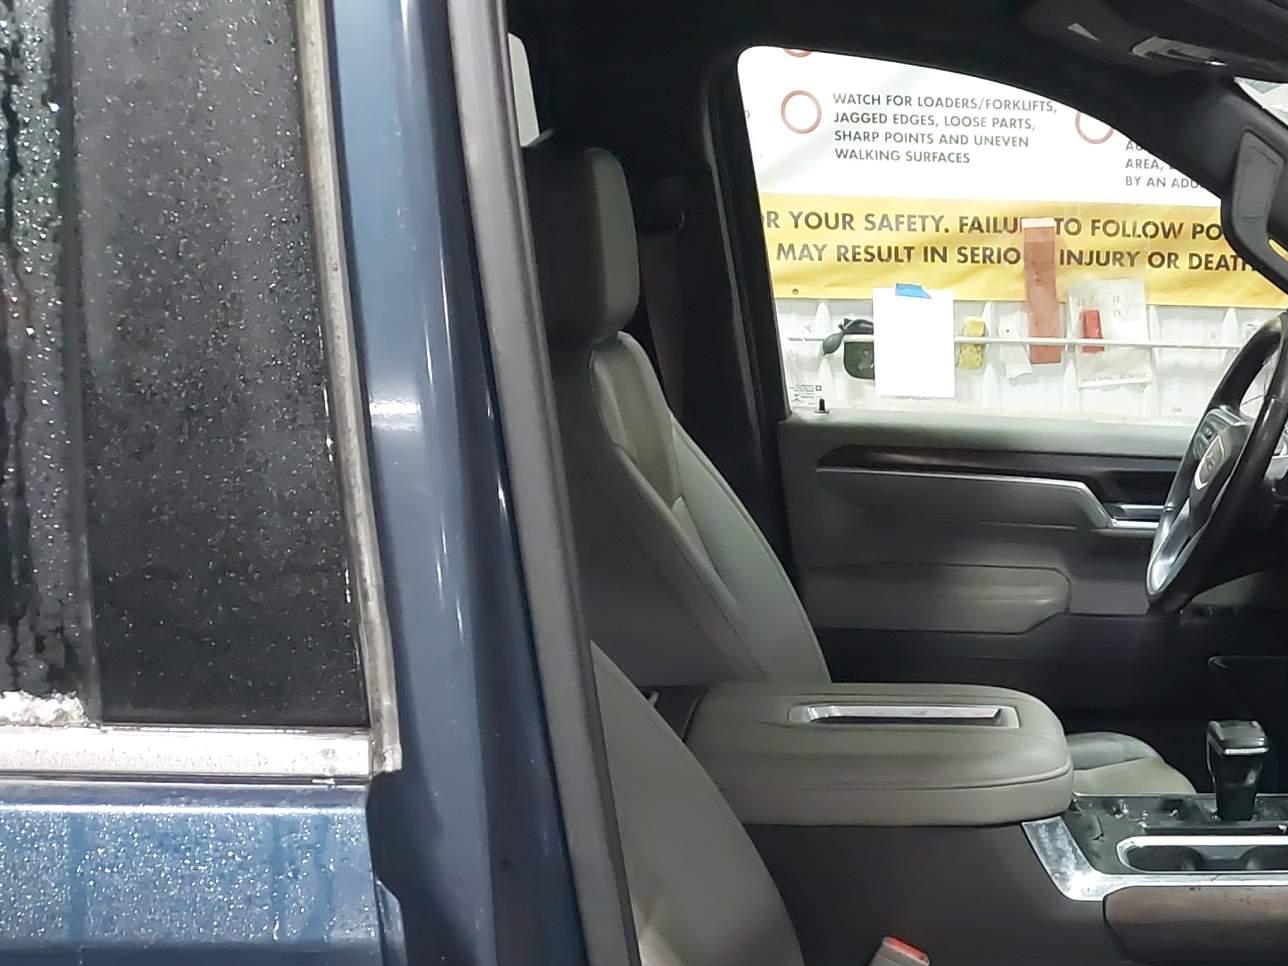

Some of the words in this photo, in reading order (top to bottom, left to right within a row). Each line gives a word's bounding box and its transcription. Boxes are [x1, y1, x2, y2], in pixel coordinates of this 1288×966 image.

[833, 92, 881, 106] WATCH
[886, 94, 912, 107] FOR
[917, 96, 1057, 114] LOADERS/FORKLIFTS,
[833, 112, 887, 126] JAGGED
[893, 114, 939, 128] EDGES,
[944, 116, 987, 128] LOOSE
[991, 117, 1036, 131] PARTS,
[834, 130, 879, 142] SHARP
[884, 133, 934, 145] POINTS
[939, 134, 969, 146] AND
[973, 135, 1029, 148] UNEVEN
[835, 148, 900, 162] WALKING
[905, 151, 971, 164] SURFACES
[1125, 159, 1164, 171] AREA,
[1125, 176, 1141, 186] BY
[1147, 177, 1166, 188] AN
[788, 211, 855, 231] YOUR
[864, 213, 950, 233] SAFETY.
[958, 216, 1022, 234] FAILU
[1055, 219, 1082, 236] TO
[1090, 219, 1183, 240] FOLLOW
[776, 243, 828, 262] MAY
[836, 245, 914, 264] RESULT
[923, 246, 948, 264] IN
[957, 247, 1021, 265] SERIO
[1059, 249, 1141, 267] INJURY
[1148, 251, 1180, 270] OR
